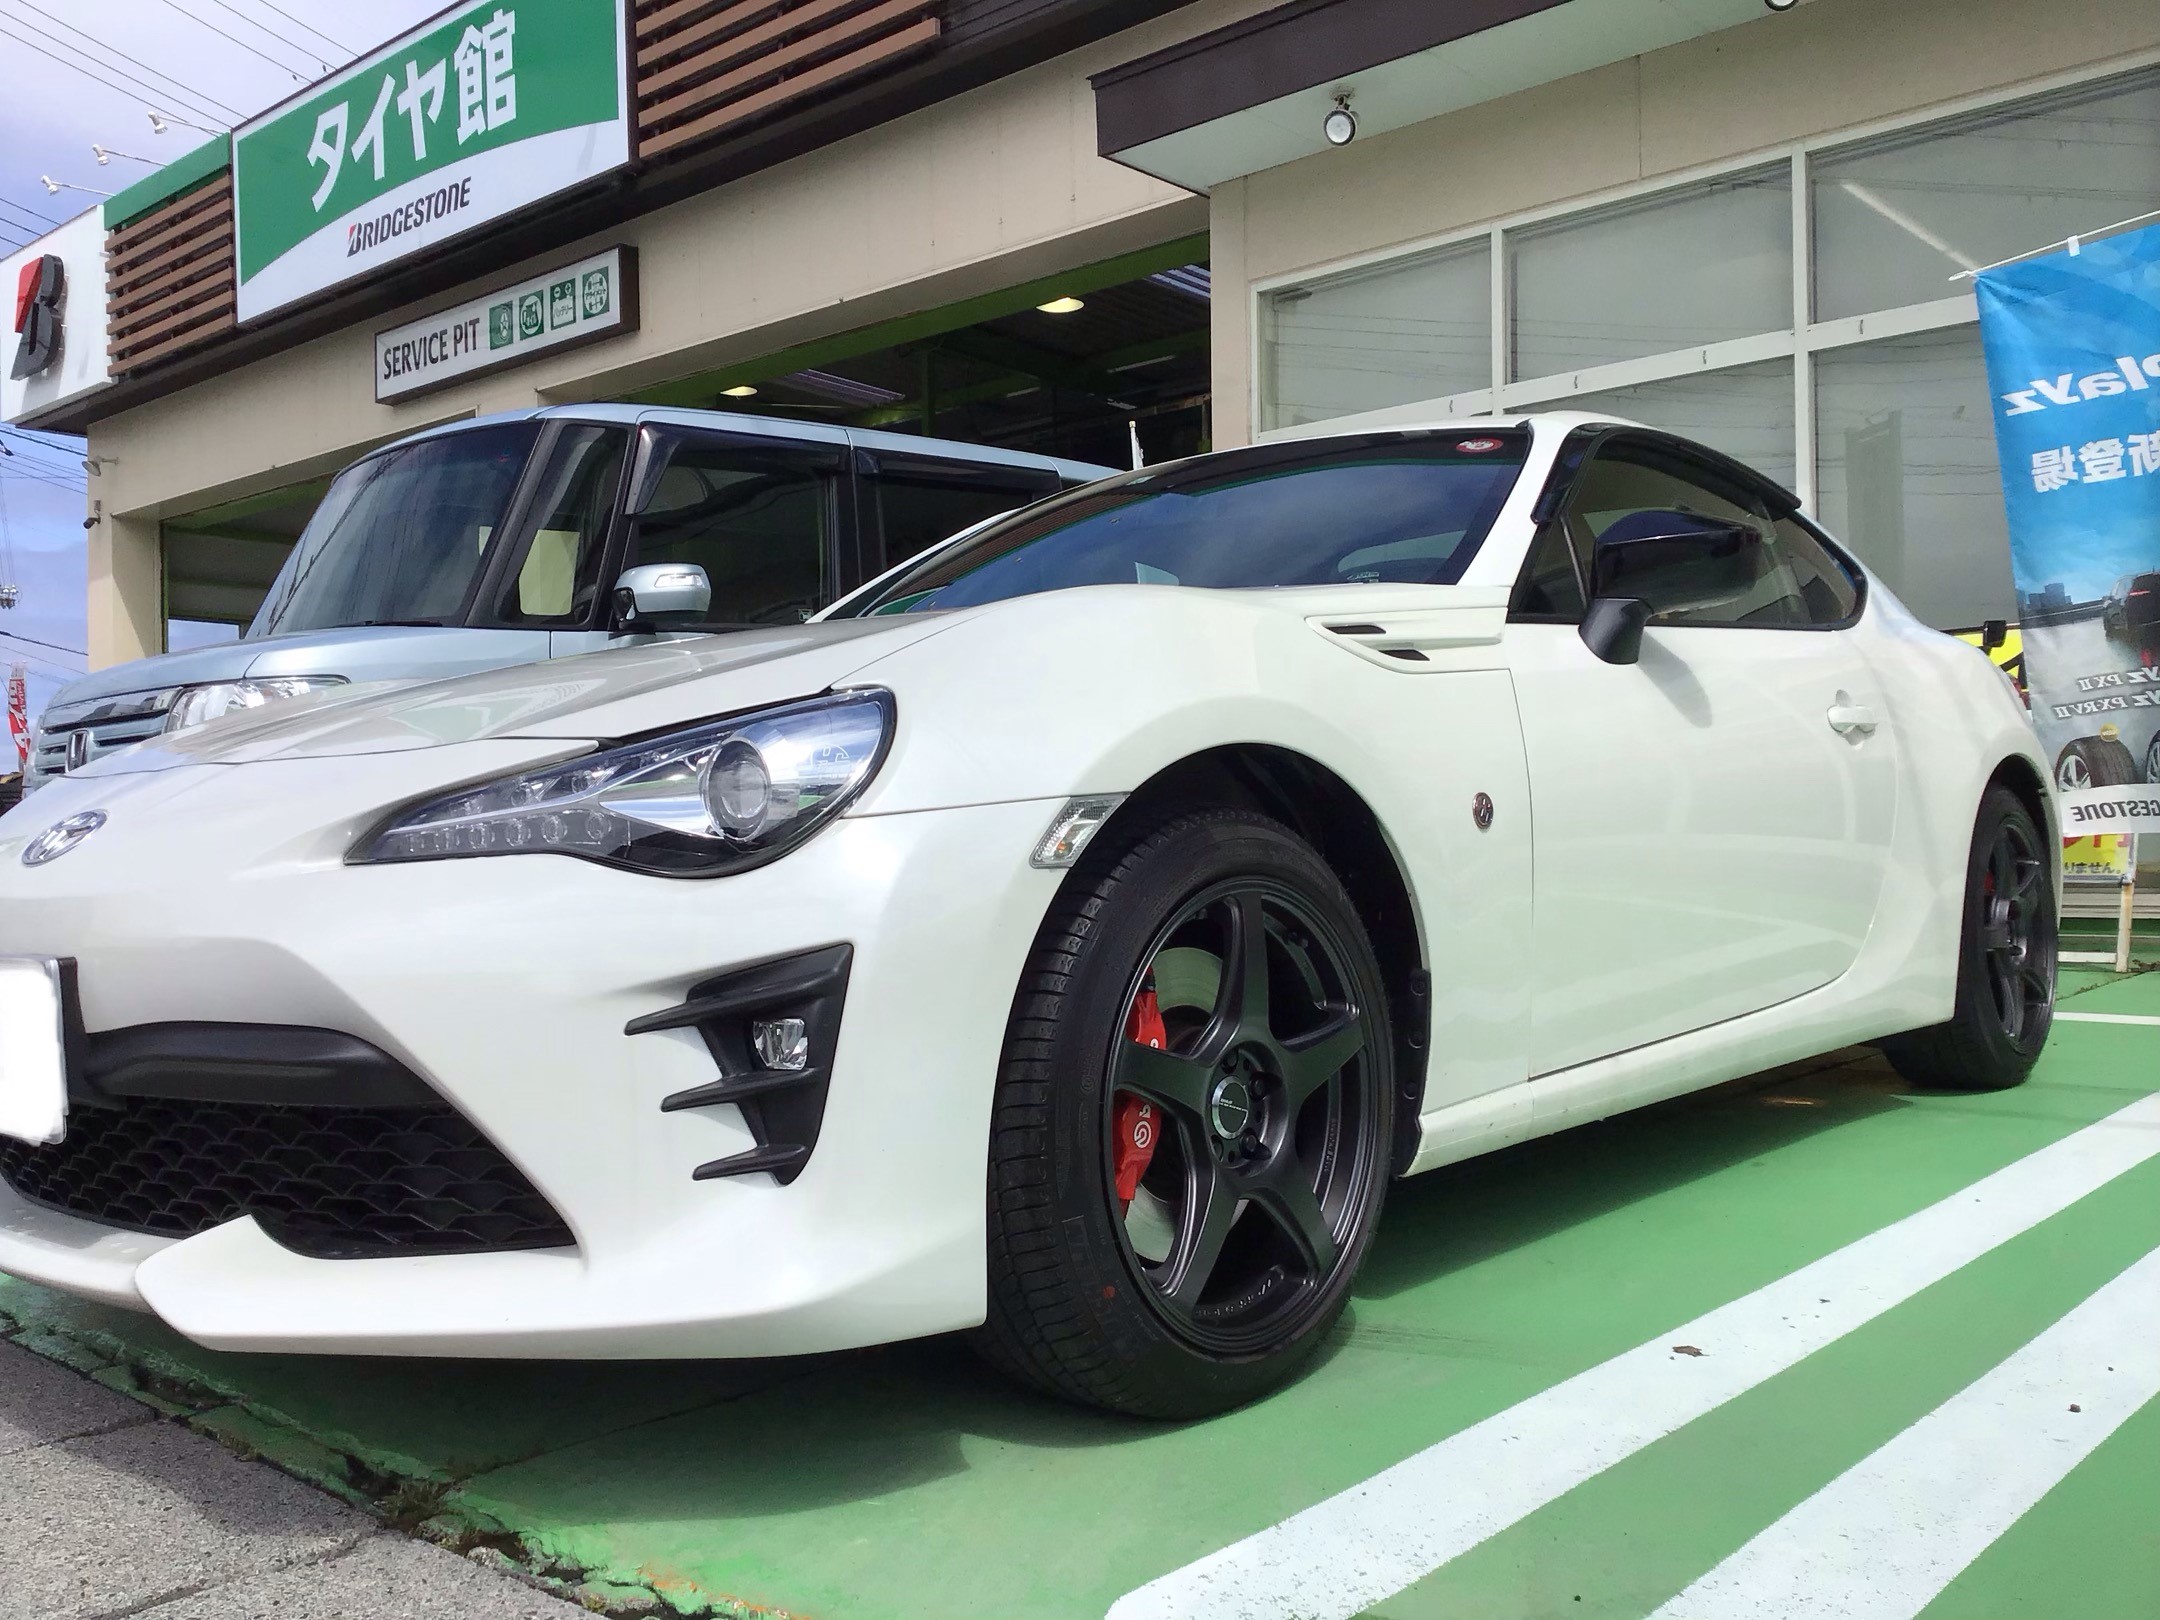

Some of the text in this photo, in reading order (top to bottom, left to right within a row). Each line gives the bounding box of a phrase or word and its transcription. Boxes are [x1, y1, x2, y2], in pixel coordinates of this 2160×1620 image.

[307, 9, 516, 212] タイヤ館
[347, 176, 471, 257] BRIDGESTONE
[384, 318, 480, 380] SERVICE PIT
